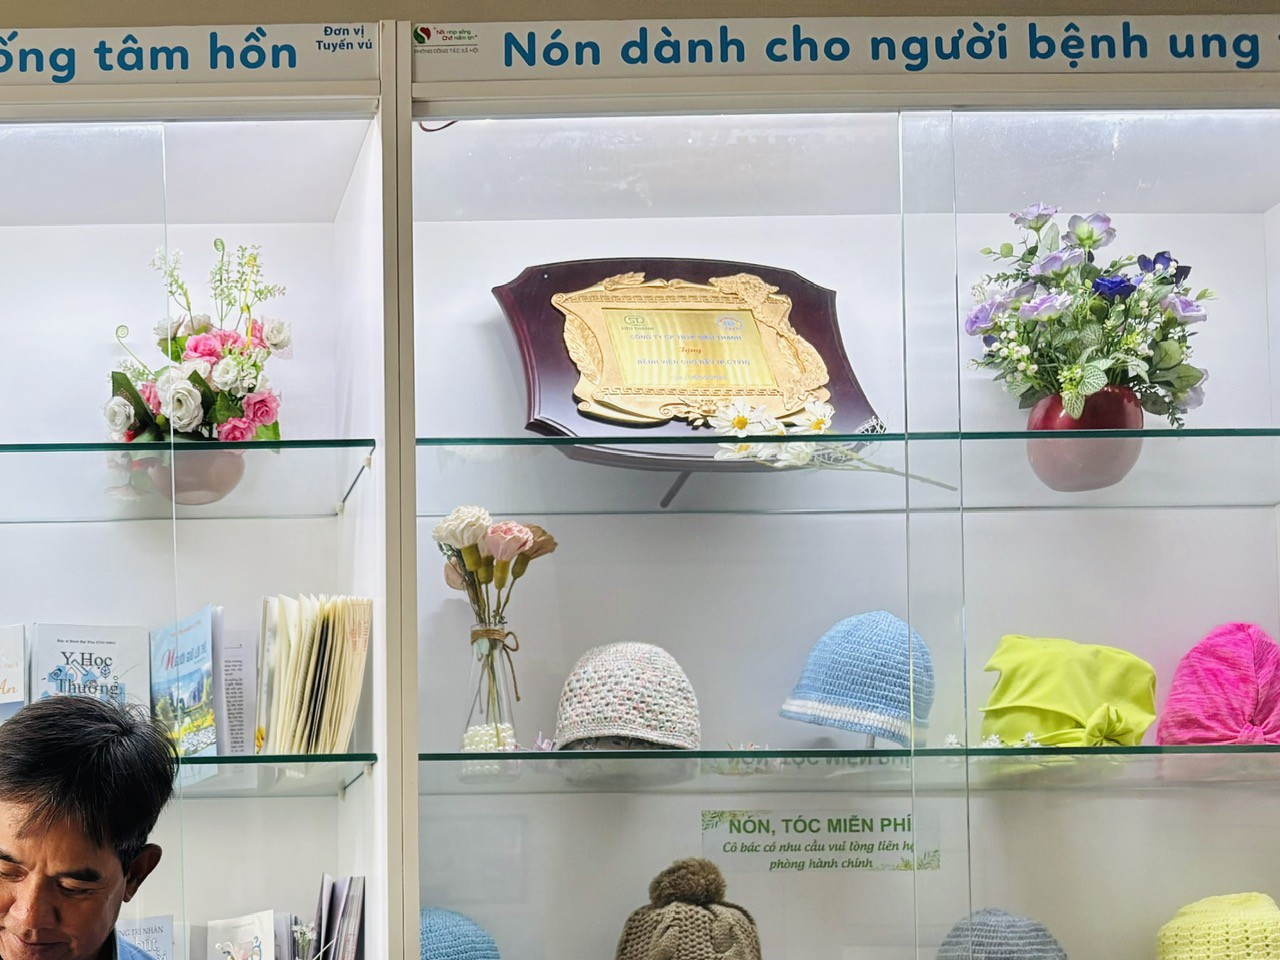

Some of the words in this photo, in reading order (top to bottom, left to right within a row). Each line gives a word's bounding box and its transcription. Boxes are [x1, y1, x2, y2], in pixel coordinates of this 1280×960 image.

[324, 26, 349, 37] Đơn
[353, 26, 365, 38] vị
[94, 34, 189, 71] tâm
[209, 26, 297, 70] hồn
[316, 39, 354, 52] Tuyến
[357, 39, 373, 50] vú
[504, 28, 601, 67] Nón
[620, 25, 746, 64] dành
[765, 24, 851, 62] cho
[871, 22, 1007, 71] người
[1028, 22, 1148, 68] bệnh
[1169, 33, 1260, 69] ung
[728, 815, 776, 836] NÓN,
[781, 814, 821, 834] TÓC
[827, 814, 874, 833] MIỄN
[880, 813, 912, 832] PHÍ
[722, 842, 738, 853] Cô
[739, 842, 761, 853] bác
[763, 842, 776, 853] có
[779, 842, 802, 852] nhu
[804, 839, 825, 852] cầu
[828, 841, 848, 852] vui
[849, 840, 875, 855] lòng
[877, 840, 899, 851] liên
[769, 857, 805, 871] phòng
[808, 857, 838, 869] hành
[841, 857, 873, 869] chính
